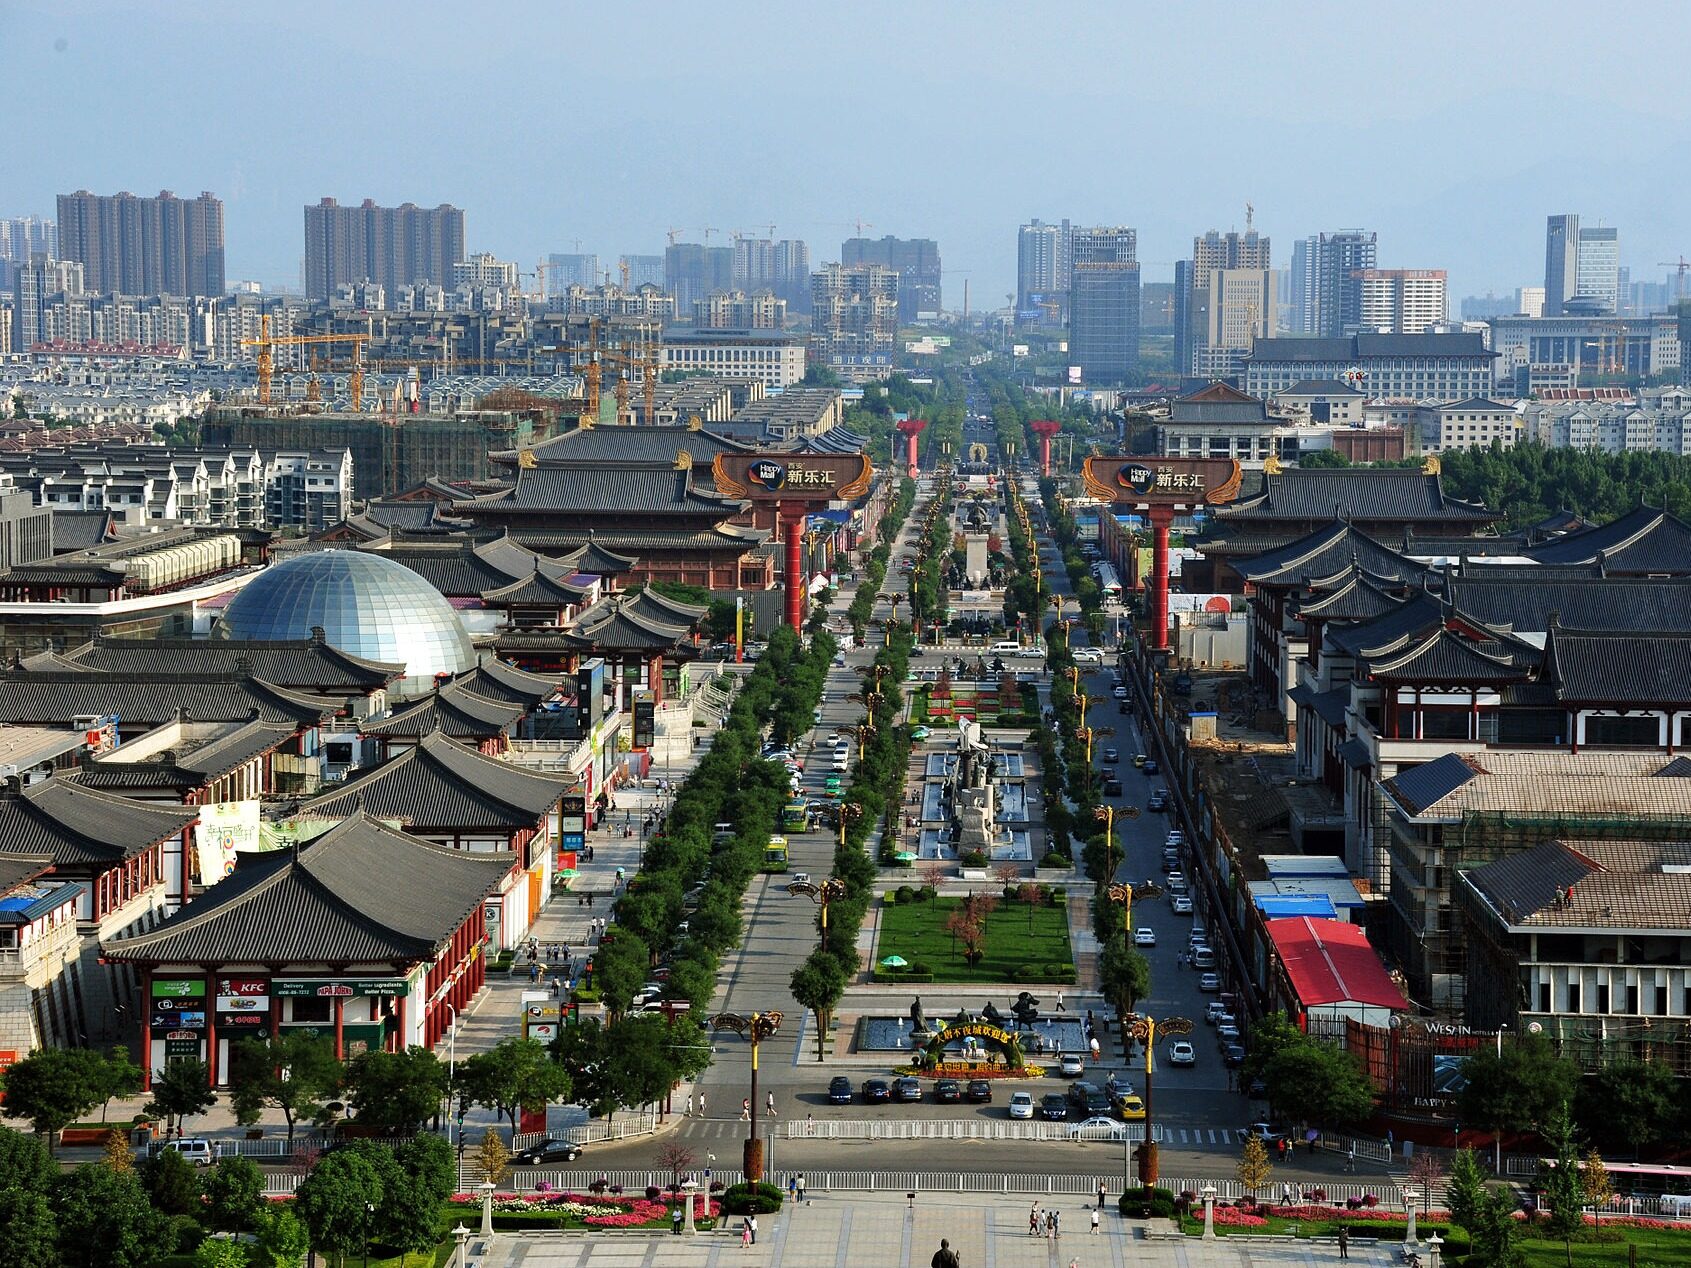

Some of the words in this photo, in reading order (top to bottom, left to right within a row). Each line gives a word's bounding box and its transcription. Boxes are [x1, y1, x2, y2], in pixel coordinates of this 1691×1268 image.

[760, 464, 782, 474] Happy
[1131, 468, 1152, 477] Happy
[1157, 465, 1173, 473] 西安
[787, 470, 836, 484] 新乐汇
[1131, 475, 1145, 483] Mall
[1156, 473, 1206, 487] 新乐汇
[241, 983, 265, 992] KFC
[1413, 1097, 1447, 1108] HAPPY
